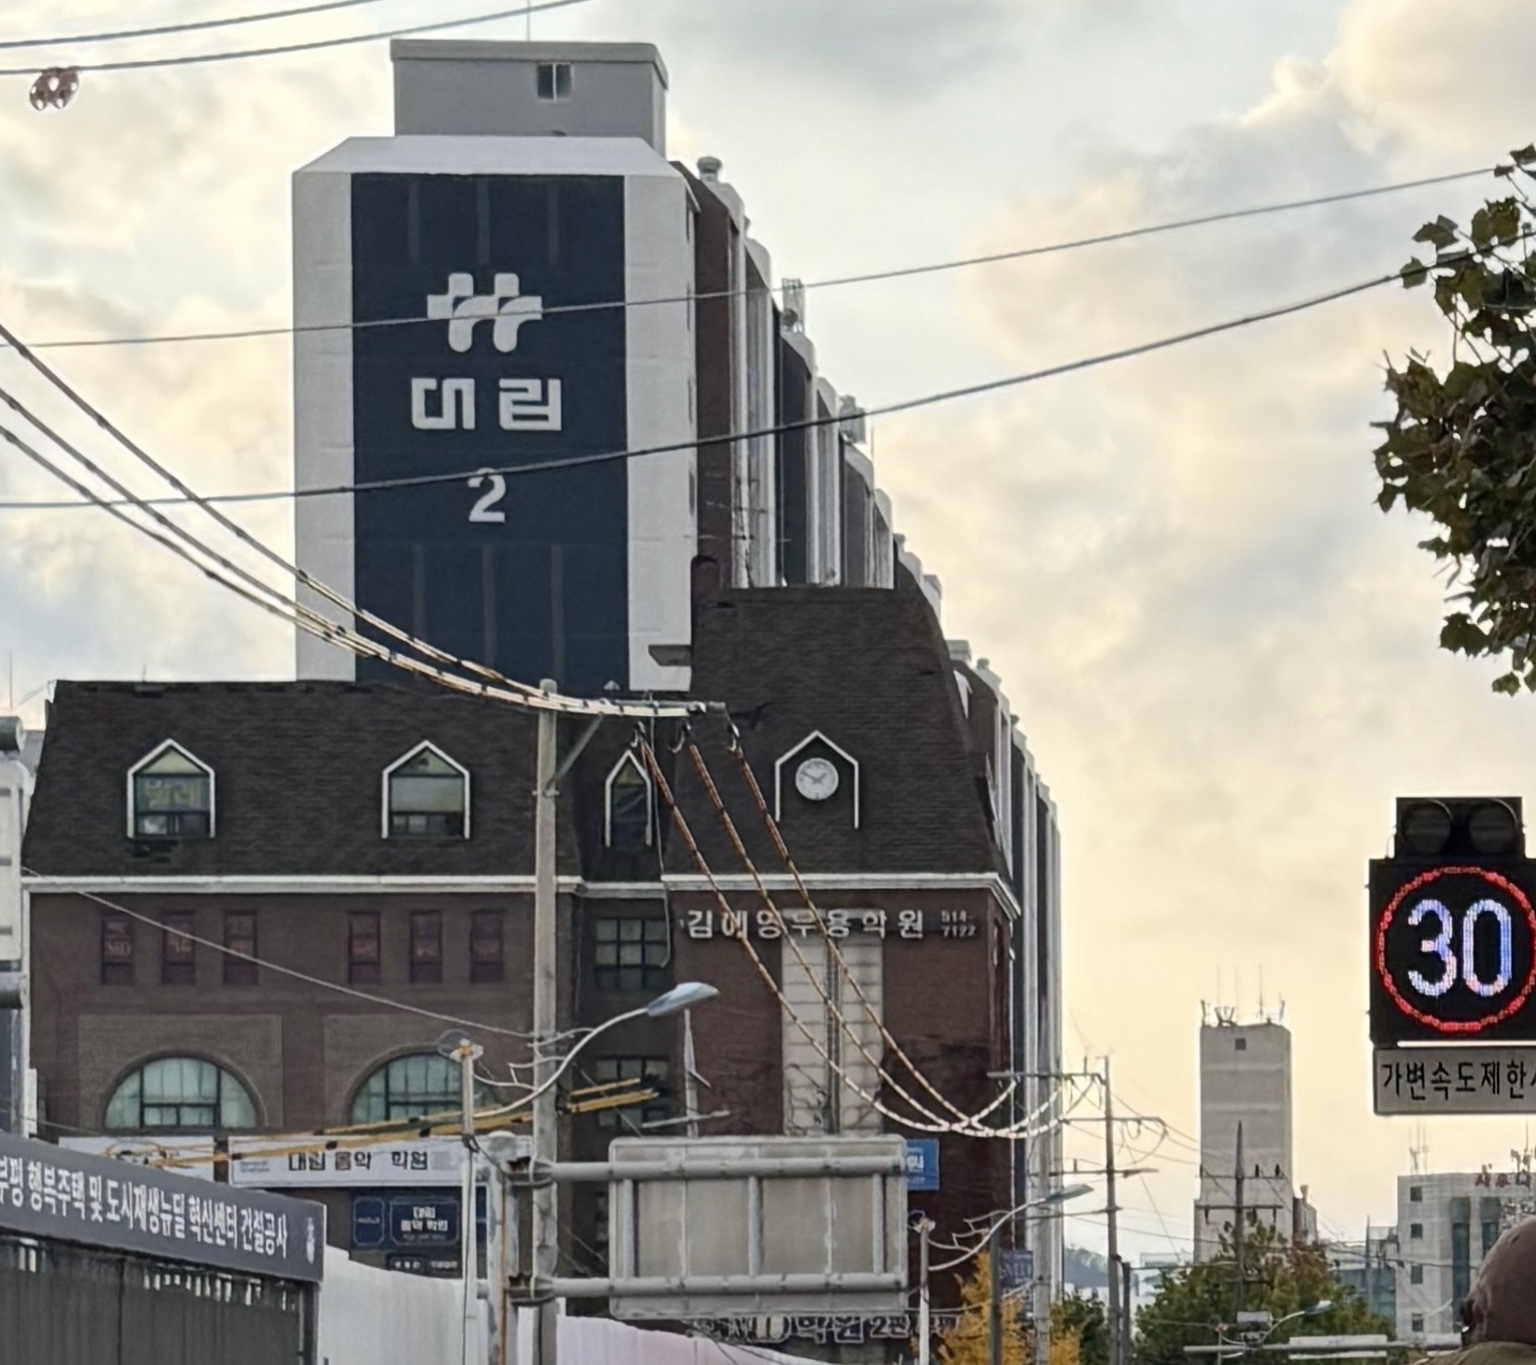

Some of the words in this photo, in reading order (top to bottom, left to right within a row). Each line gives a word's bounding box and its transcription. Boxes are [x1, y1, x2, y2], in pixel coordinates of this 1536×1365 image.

[410, 377, 562, 432] 대림
[467, 467, 506, 524] 2
[1408, 899, 1512, 998] 30
[27, 1160, 86, 1220] 행복주택
[88, 1174, 104, 1224] 및
[106, 1178, 186, 1240] 도시재생뉴딜
[188, 1194, 238, 1249] 혁신센터
[240, 1207, 288, 1260] 건설공사
